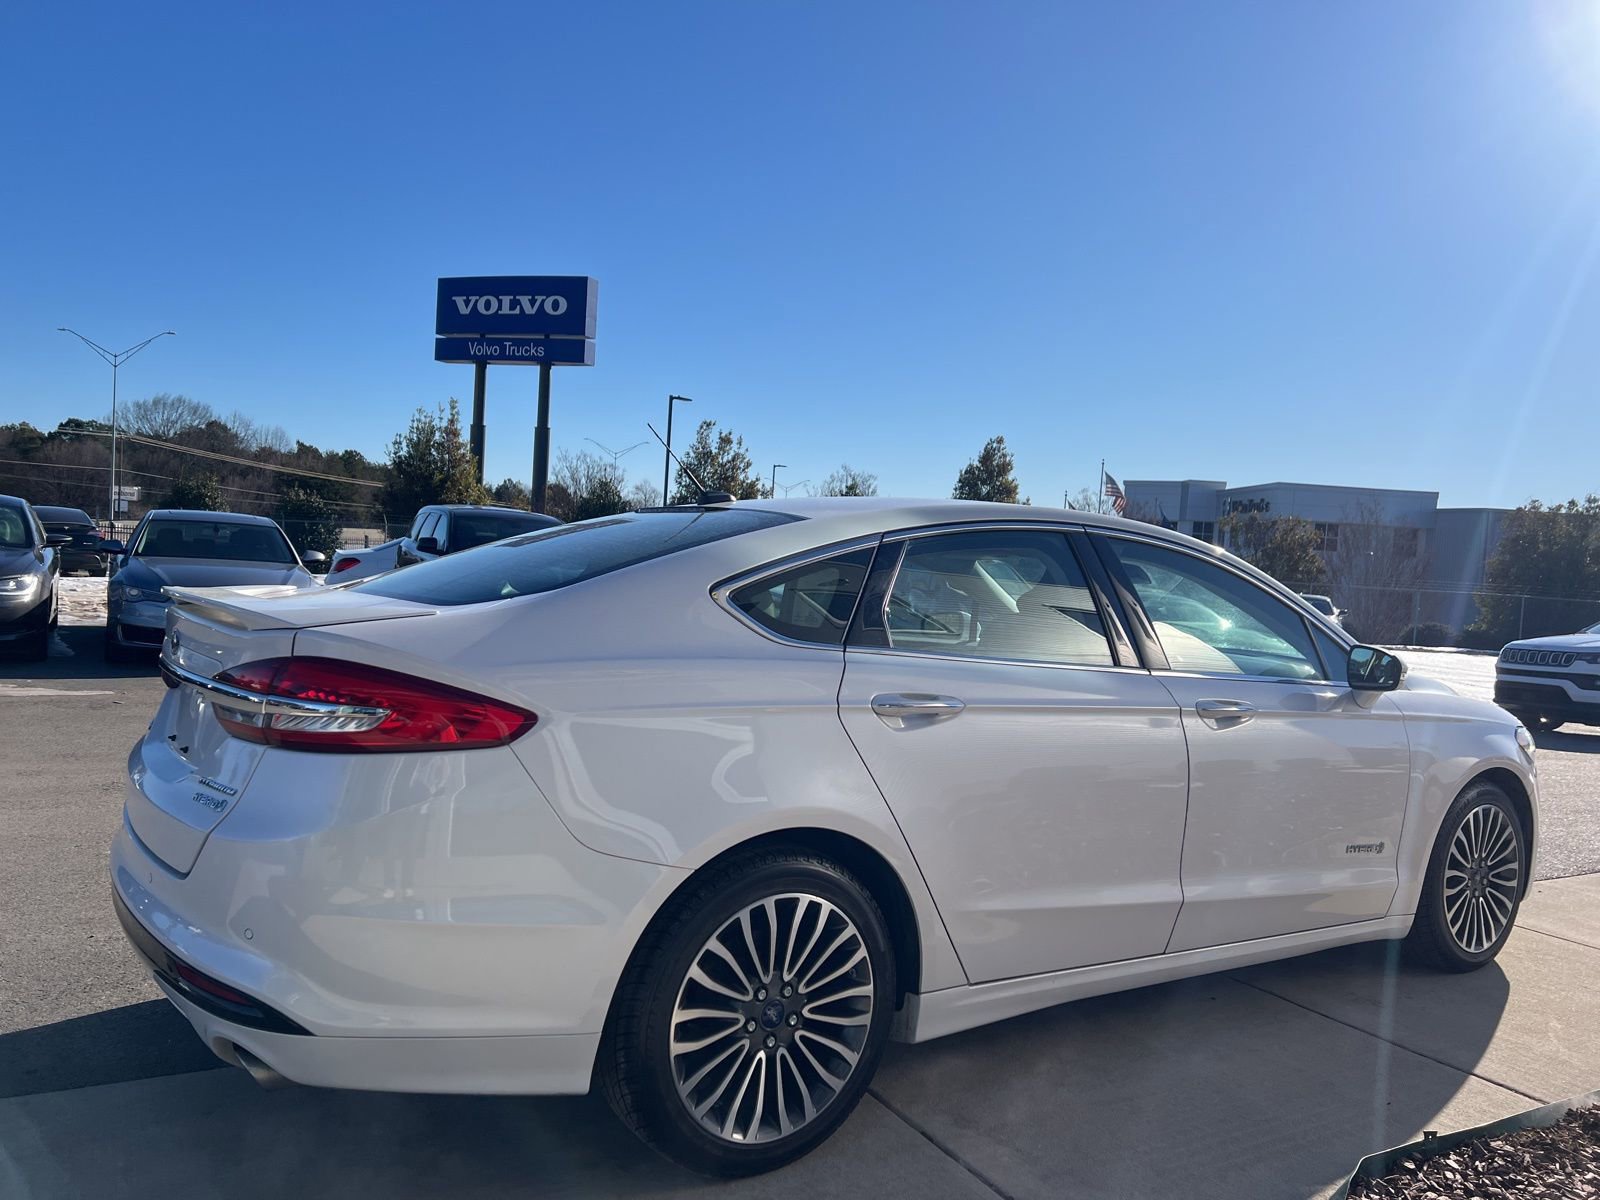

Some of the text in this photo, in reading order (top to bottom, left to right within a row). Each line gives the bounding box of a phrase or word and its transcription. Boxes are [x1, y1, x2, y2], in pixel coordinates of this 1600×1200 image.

[452, 295, 568, 315] VOLVO
[468, 341, 545, 357] Volvo Trucks
